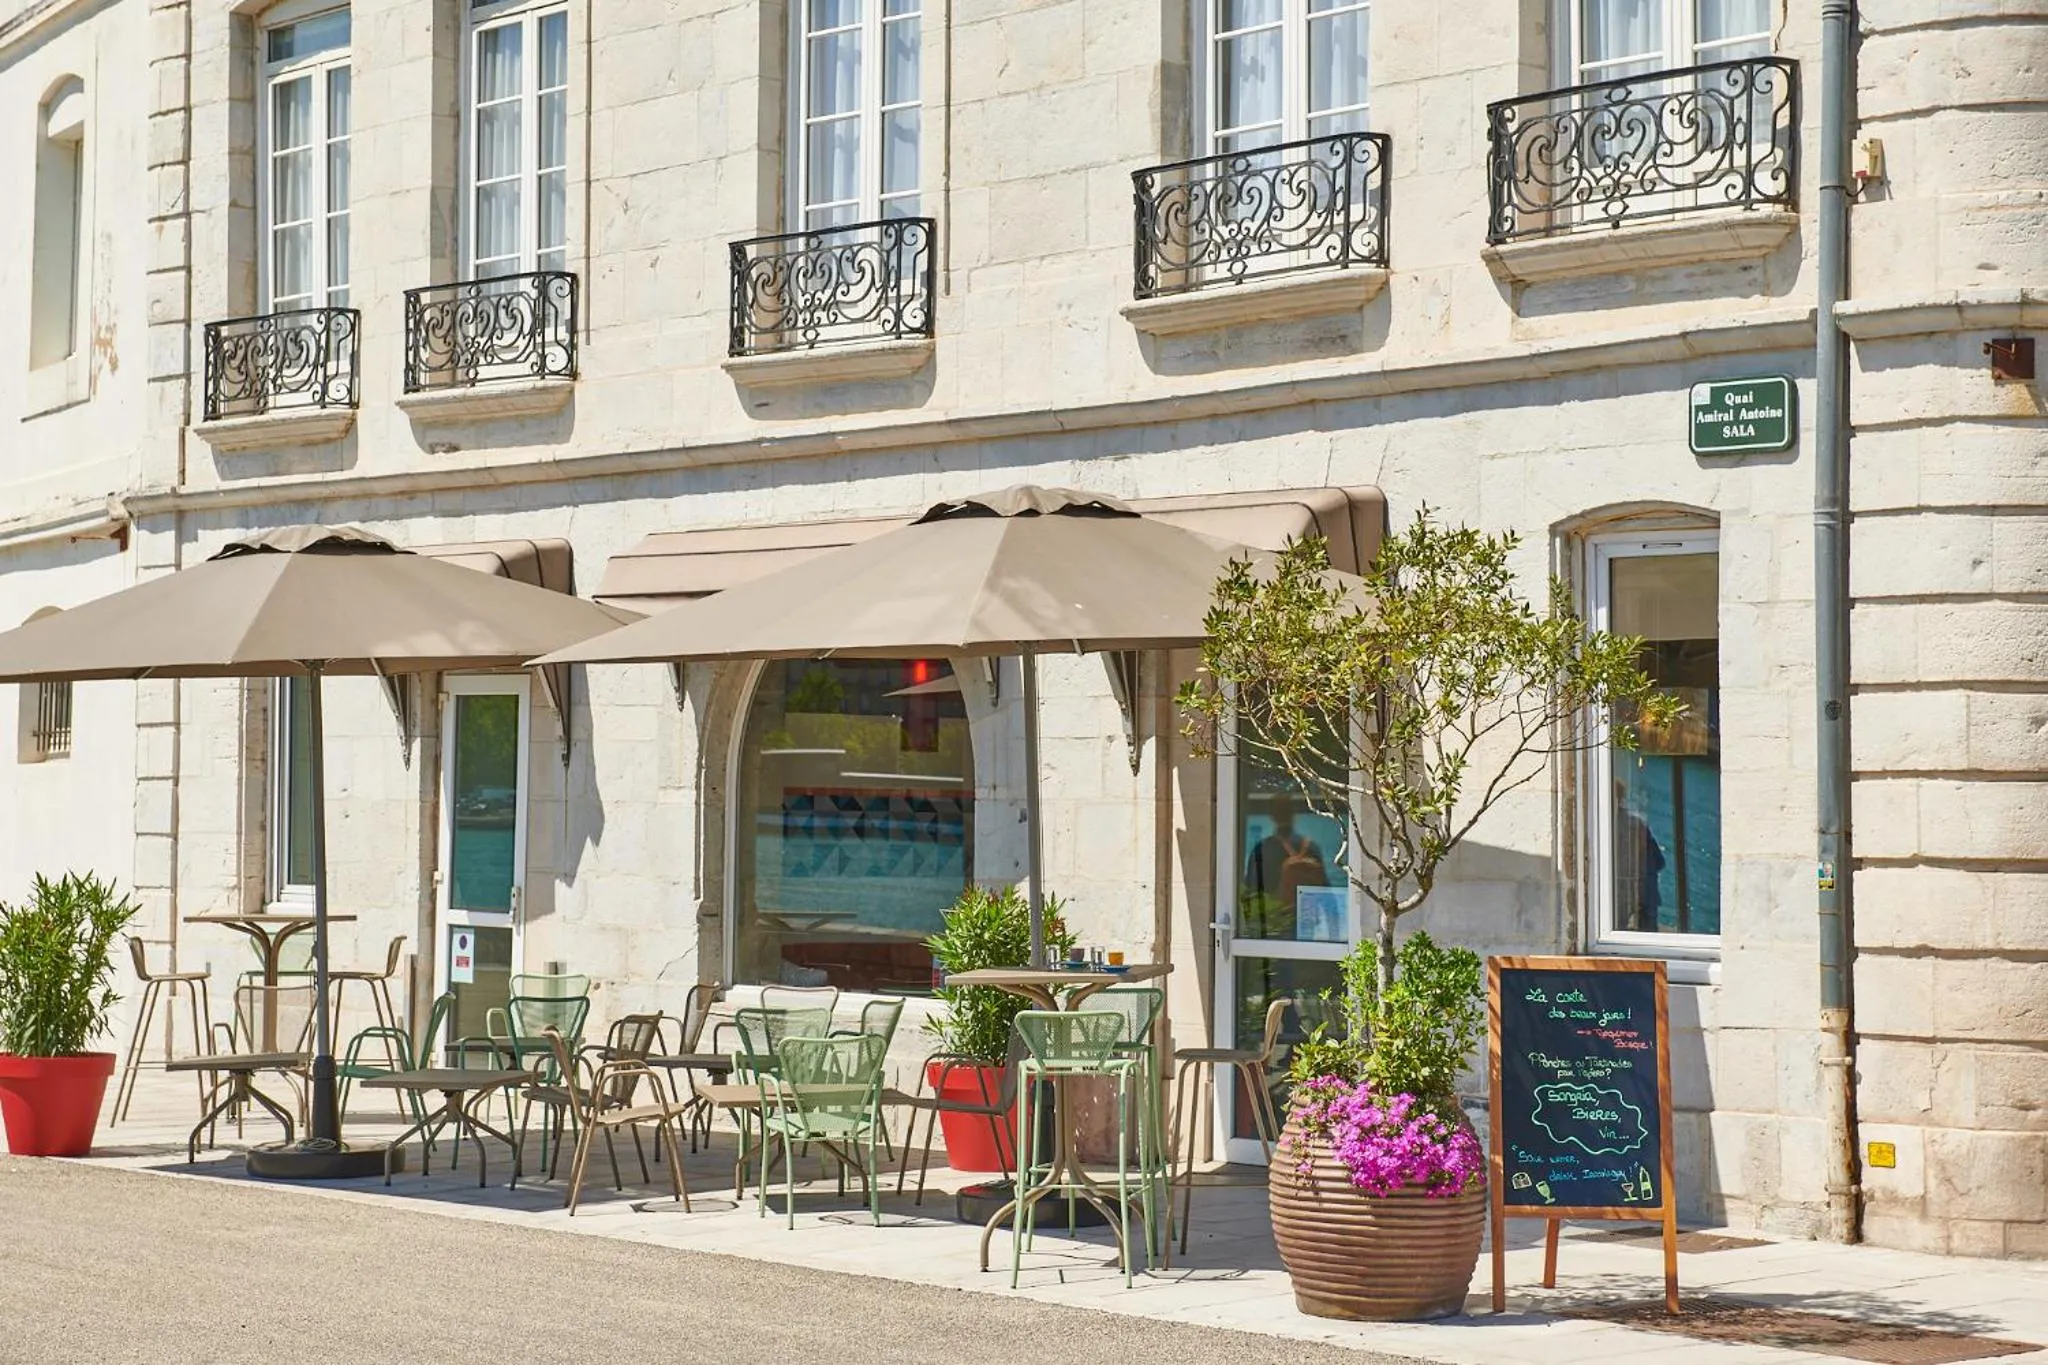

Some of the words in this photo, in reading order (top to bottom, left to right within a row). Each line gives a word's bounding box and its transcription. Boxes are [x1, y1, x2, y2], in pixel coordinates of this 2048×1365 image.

[1724, 390, 1754, 406] Quai
[1696, 409, 1734, 423] Amiral
[1740, 405, 1783, 420] Antoine
[1722, 424, 1756, 438] SALA
[1525, 988, 1548, 1003] La
